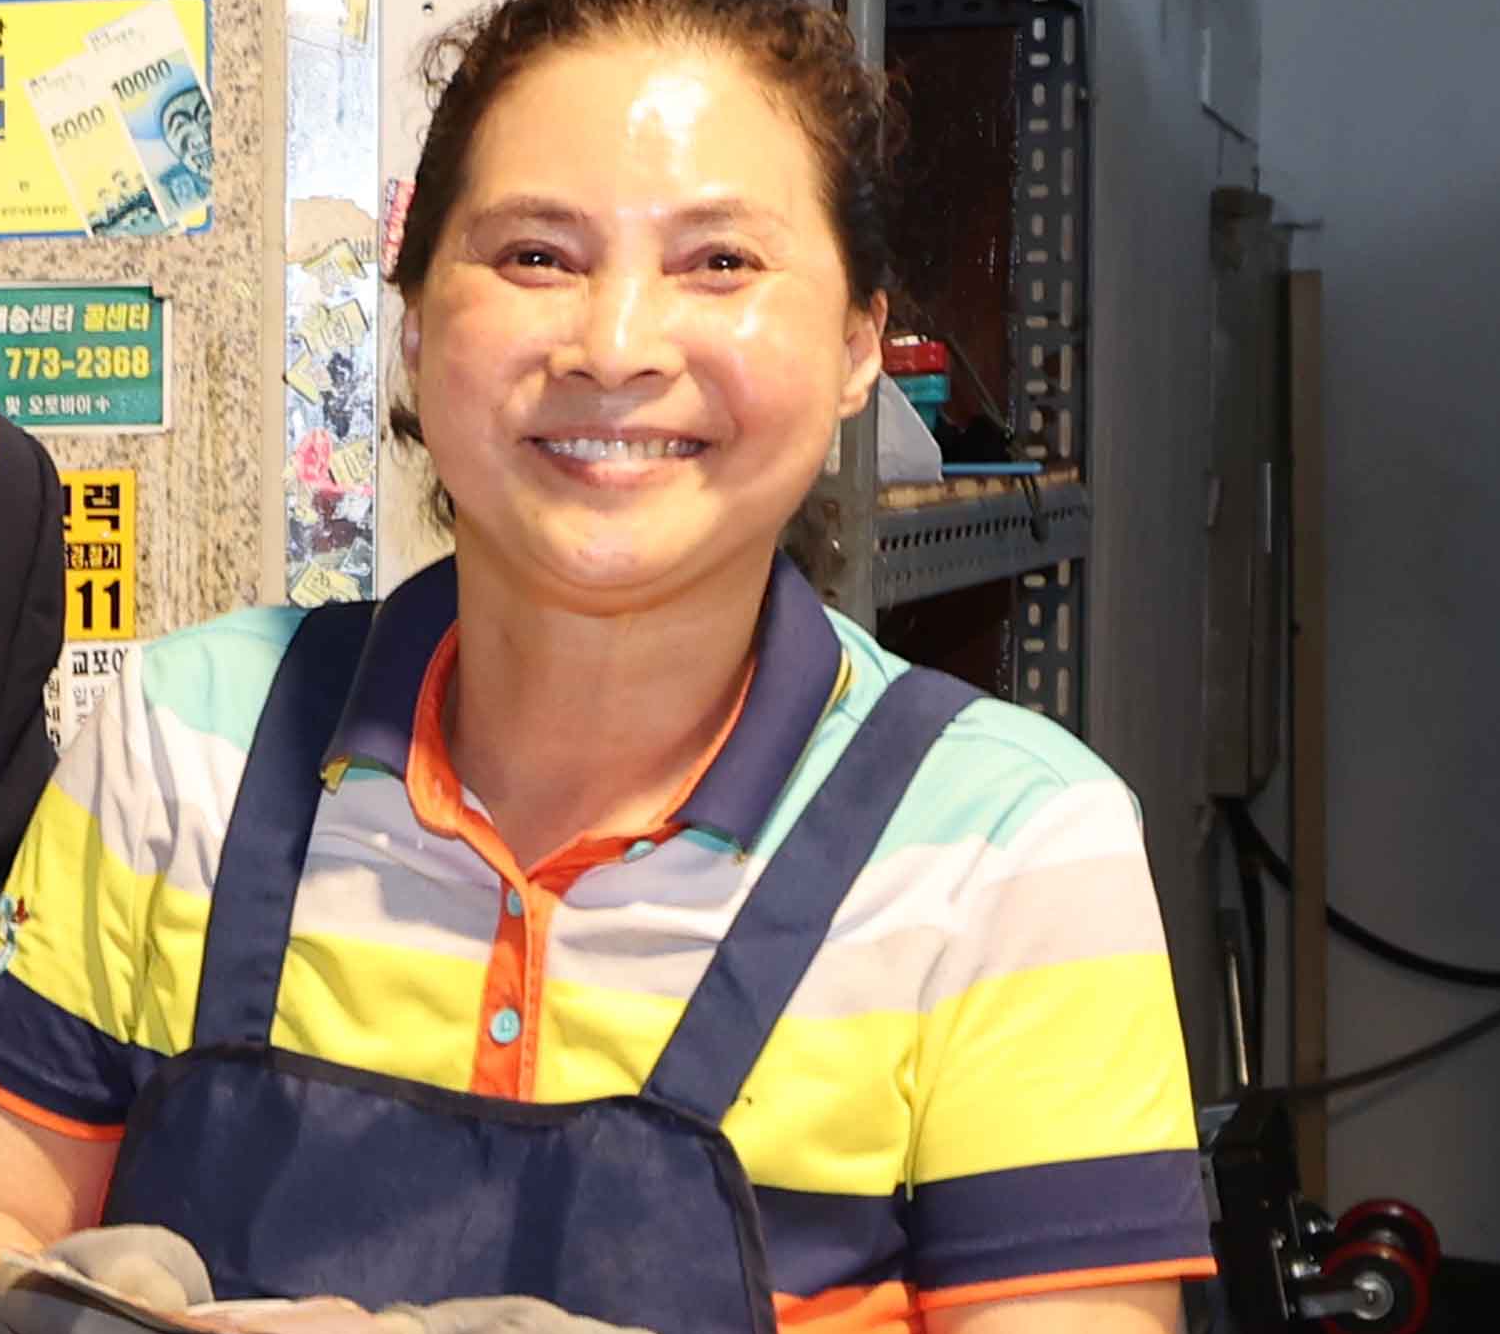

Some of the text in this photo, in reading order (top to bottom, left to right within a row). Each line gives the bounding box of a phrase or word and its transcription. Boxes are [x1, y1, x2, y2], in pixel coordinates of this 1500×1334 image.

[111, 58, 174, 102] 10000
[50, 105, 106, 147] 5000
[5, 345, 151, 381] 773-2368
